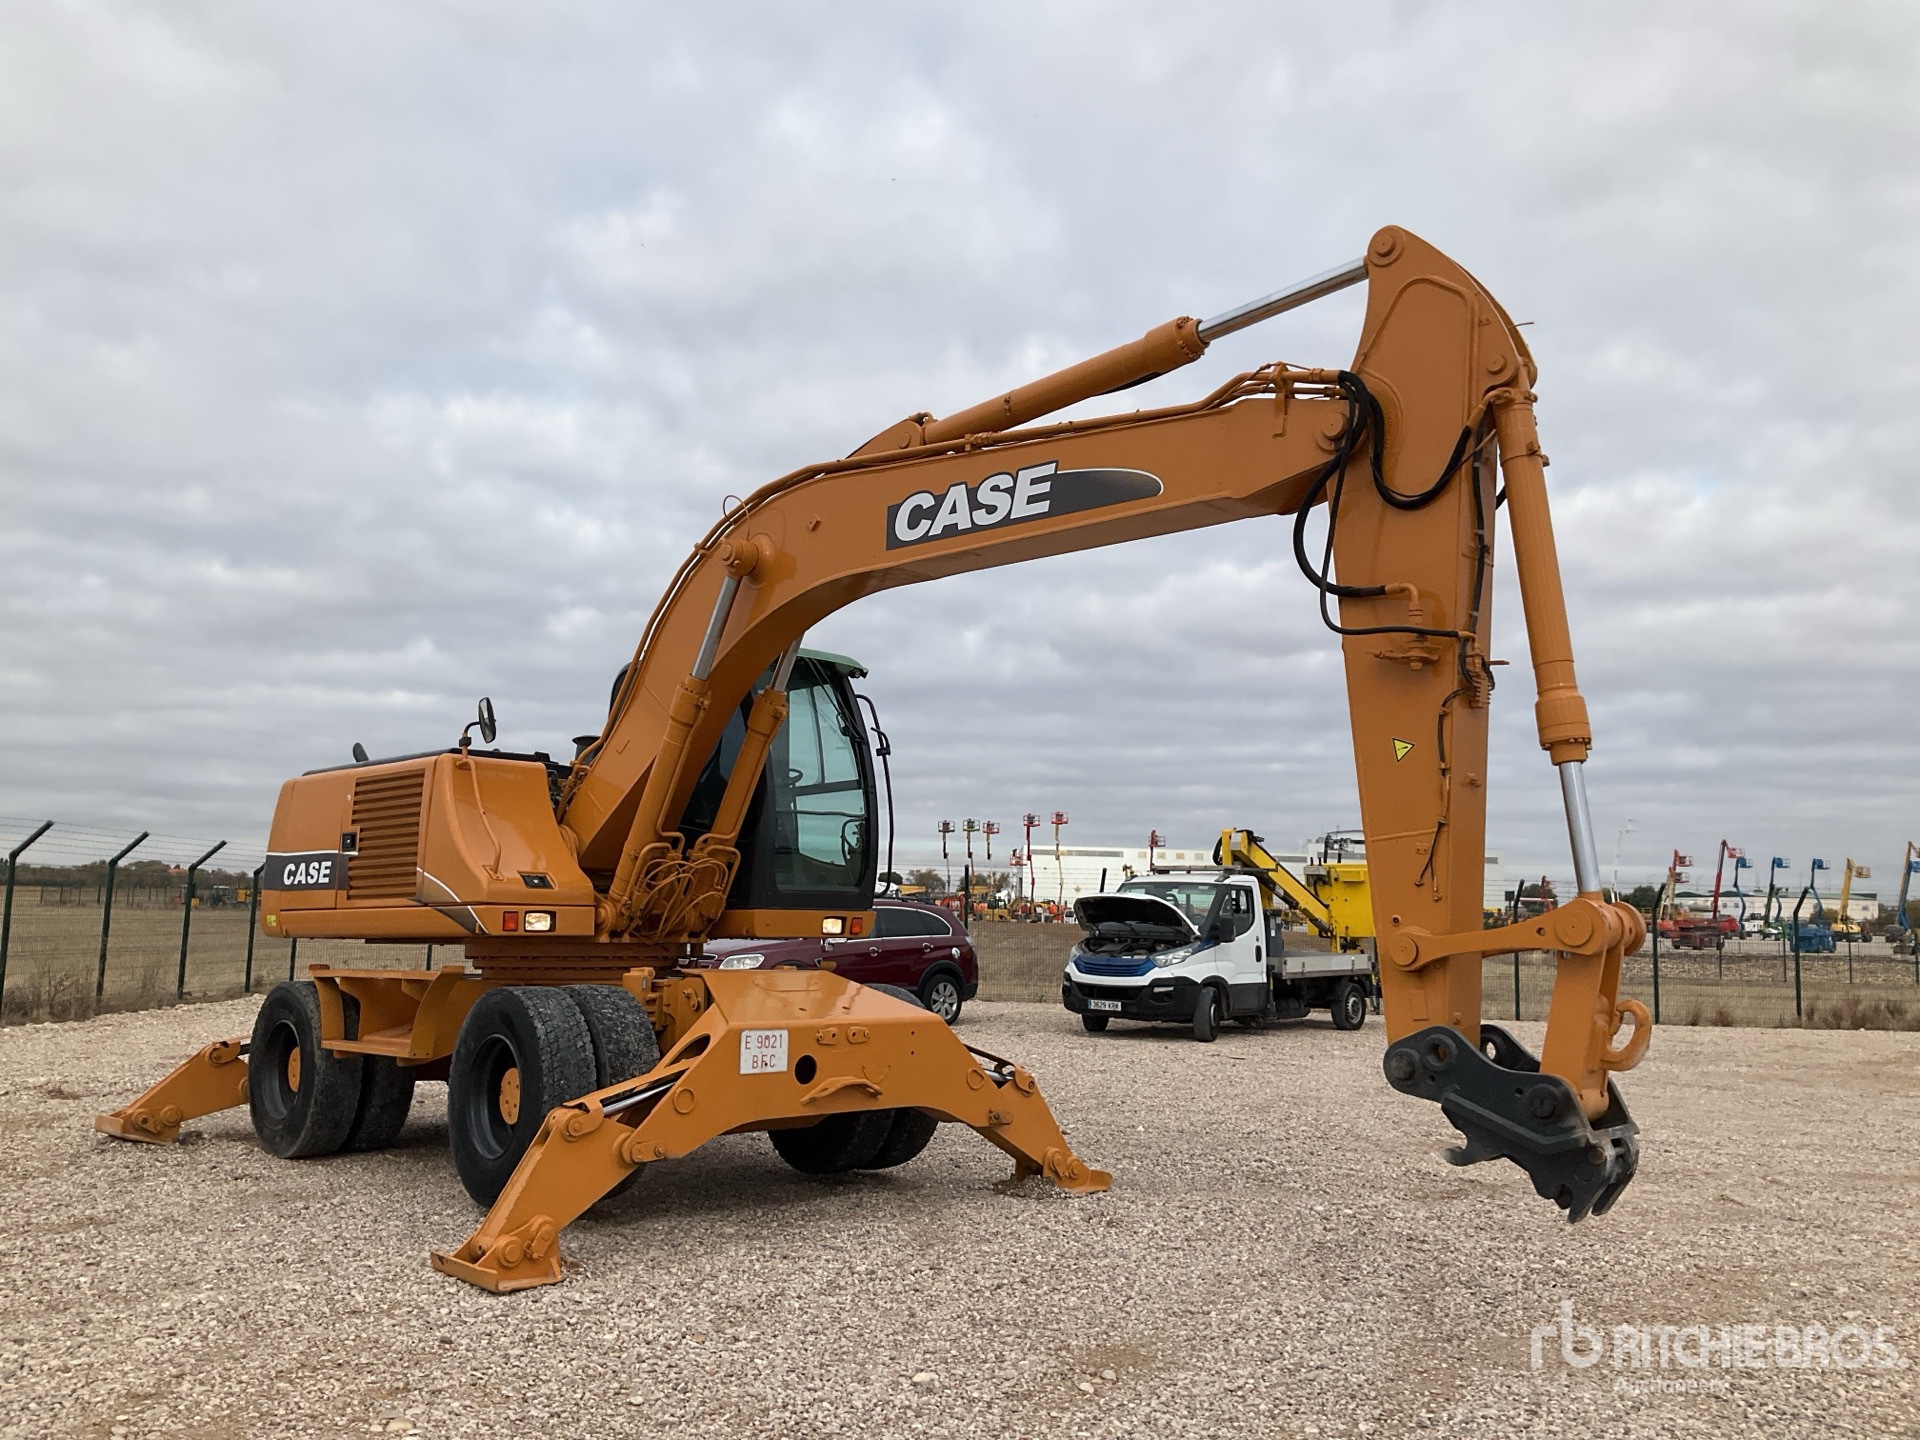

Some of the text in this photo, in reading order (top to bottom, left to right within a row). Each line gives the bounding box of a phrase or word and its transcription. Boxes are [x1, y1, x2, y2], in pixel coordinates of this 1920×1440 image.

[894, 461, 1058, 542] CASE
[283, 861, 332, 885] CASE
[745, 1034, 783, 1050] E 9021
[752, 1054, 776, 1069] BFC
